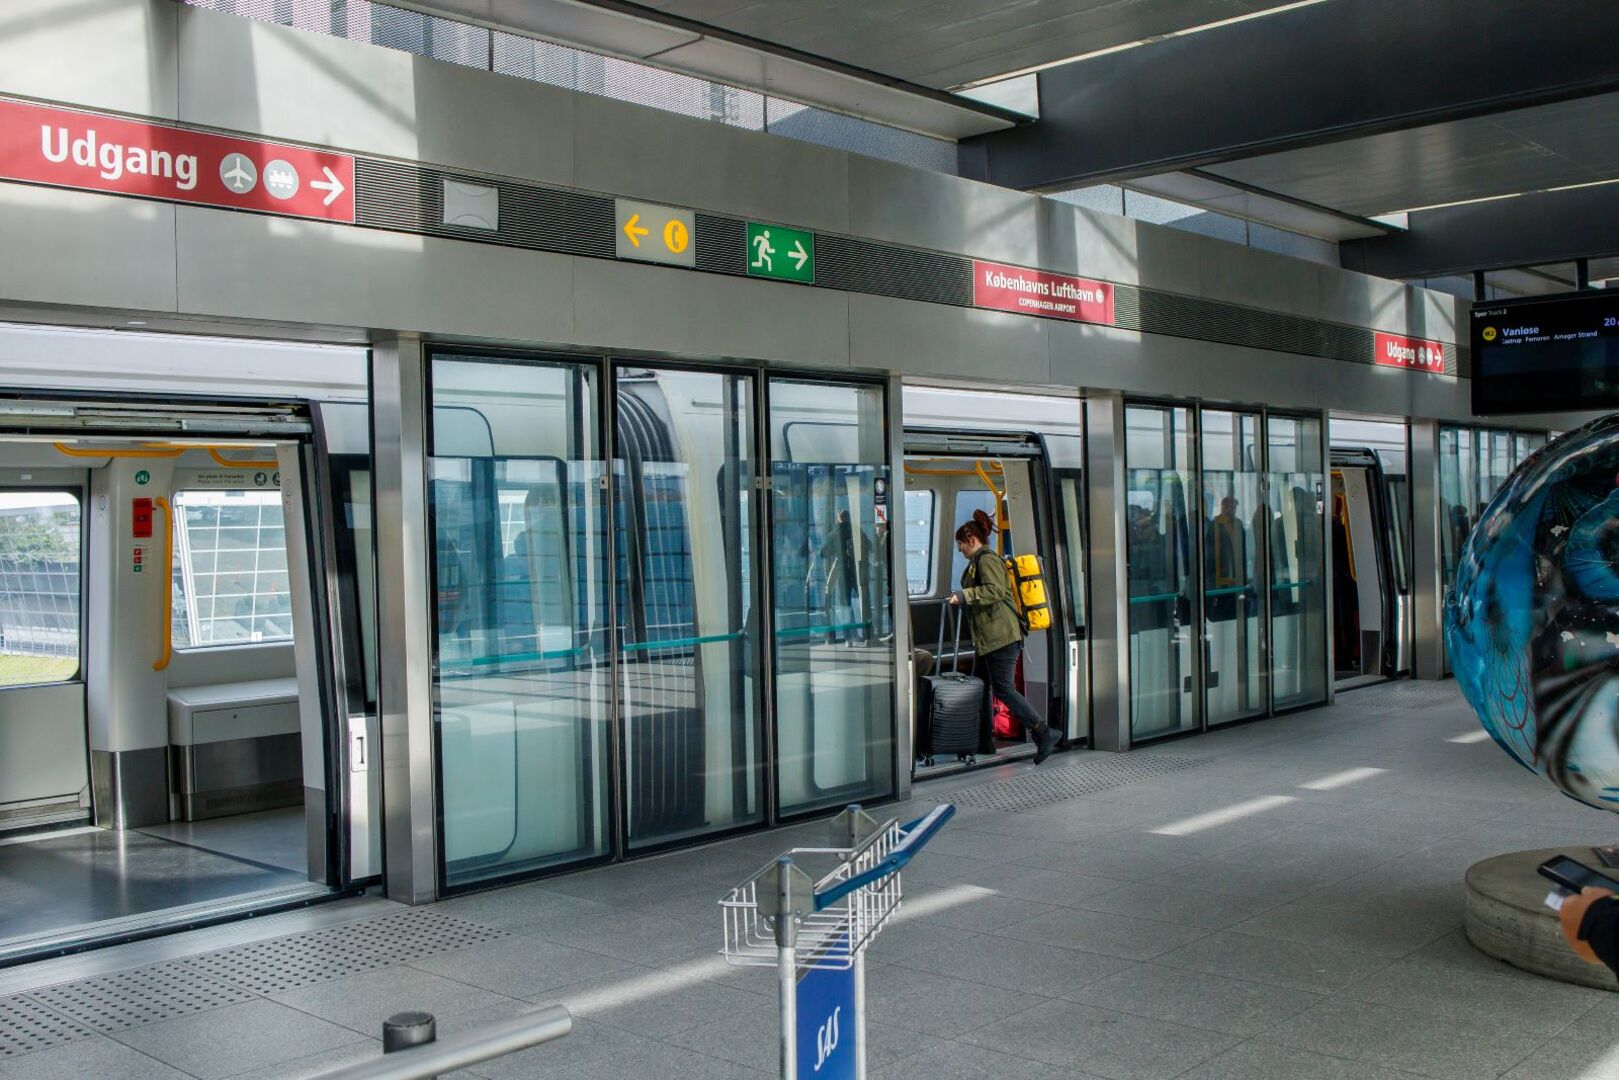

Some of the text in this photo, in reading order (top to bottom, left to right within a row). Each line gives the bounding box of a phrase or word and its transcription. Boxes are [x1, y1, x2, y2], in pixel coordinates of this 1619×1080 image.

[41, 125, 198, 190] Udgang
[986, 271, 1093, 302] Københavns Lufthavn
[1019, 298, 1076, 313] COPENHAGEN AIRPORT
[1604, 317, 1616, 327] 20
[1578, 330, 1597, 338] Strand
[1387, 341, 1415, 364] Udgang
[814, 1006, 840, 1071] SAS
